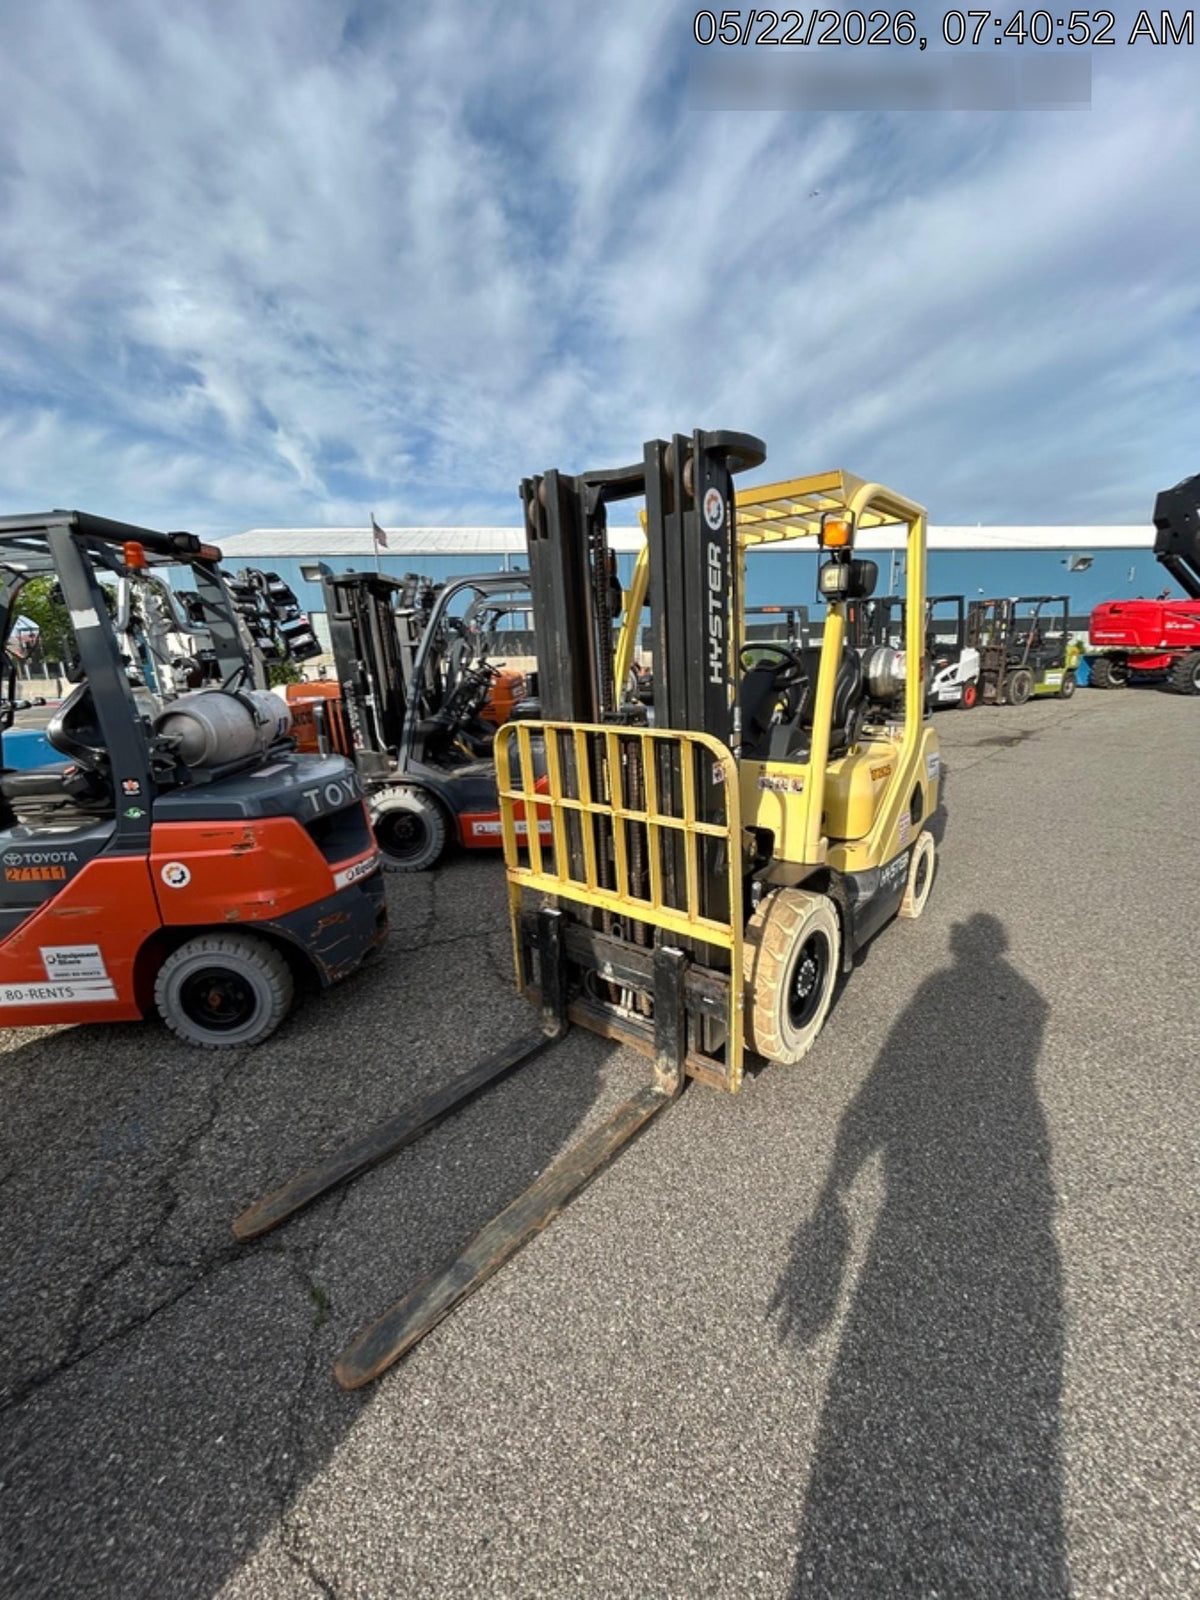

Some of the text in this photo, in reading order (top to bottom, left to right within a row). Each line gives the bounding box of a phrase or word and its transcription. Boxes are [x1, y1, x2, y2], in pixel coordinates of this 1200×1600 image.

[707, 541, 722, 684] HYSTER
[24, 851, 78, 863] TOYOTA
[5, 986, 75, 1001] 80-RENTS
